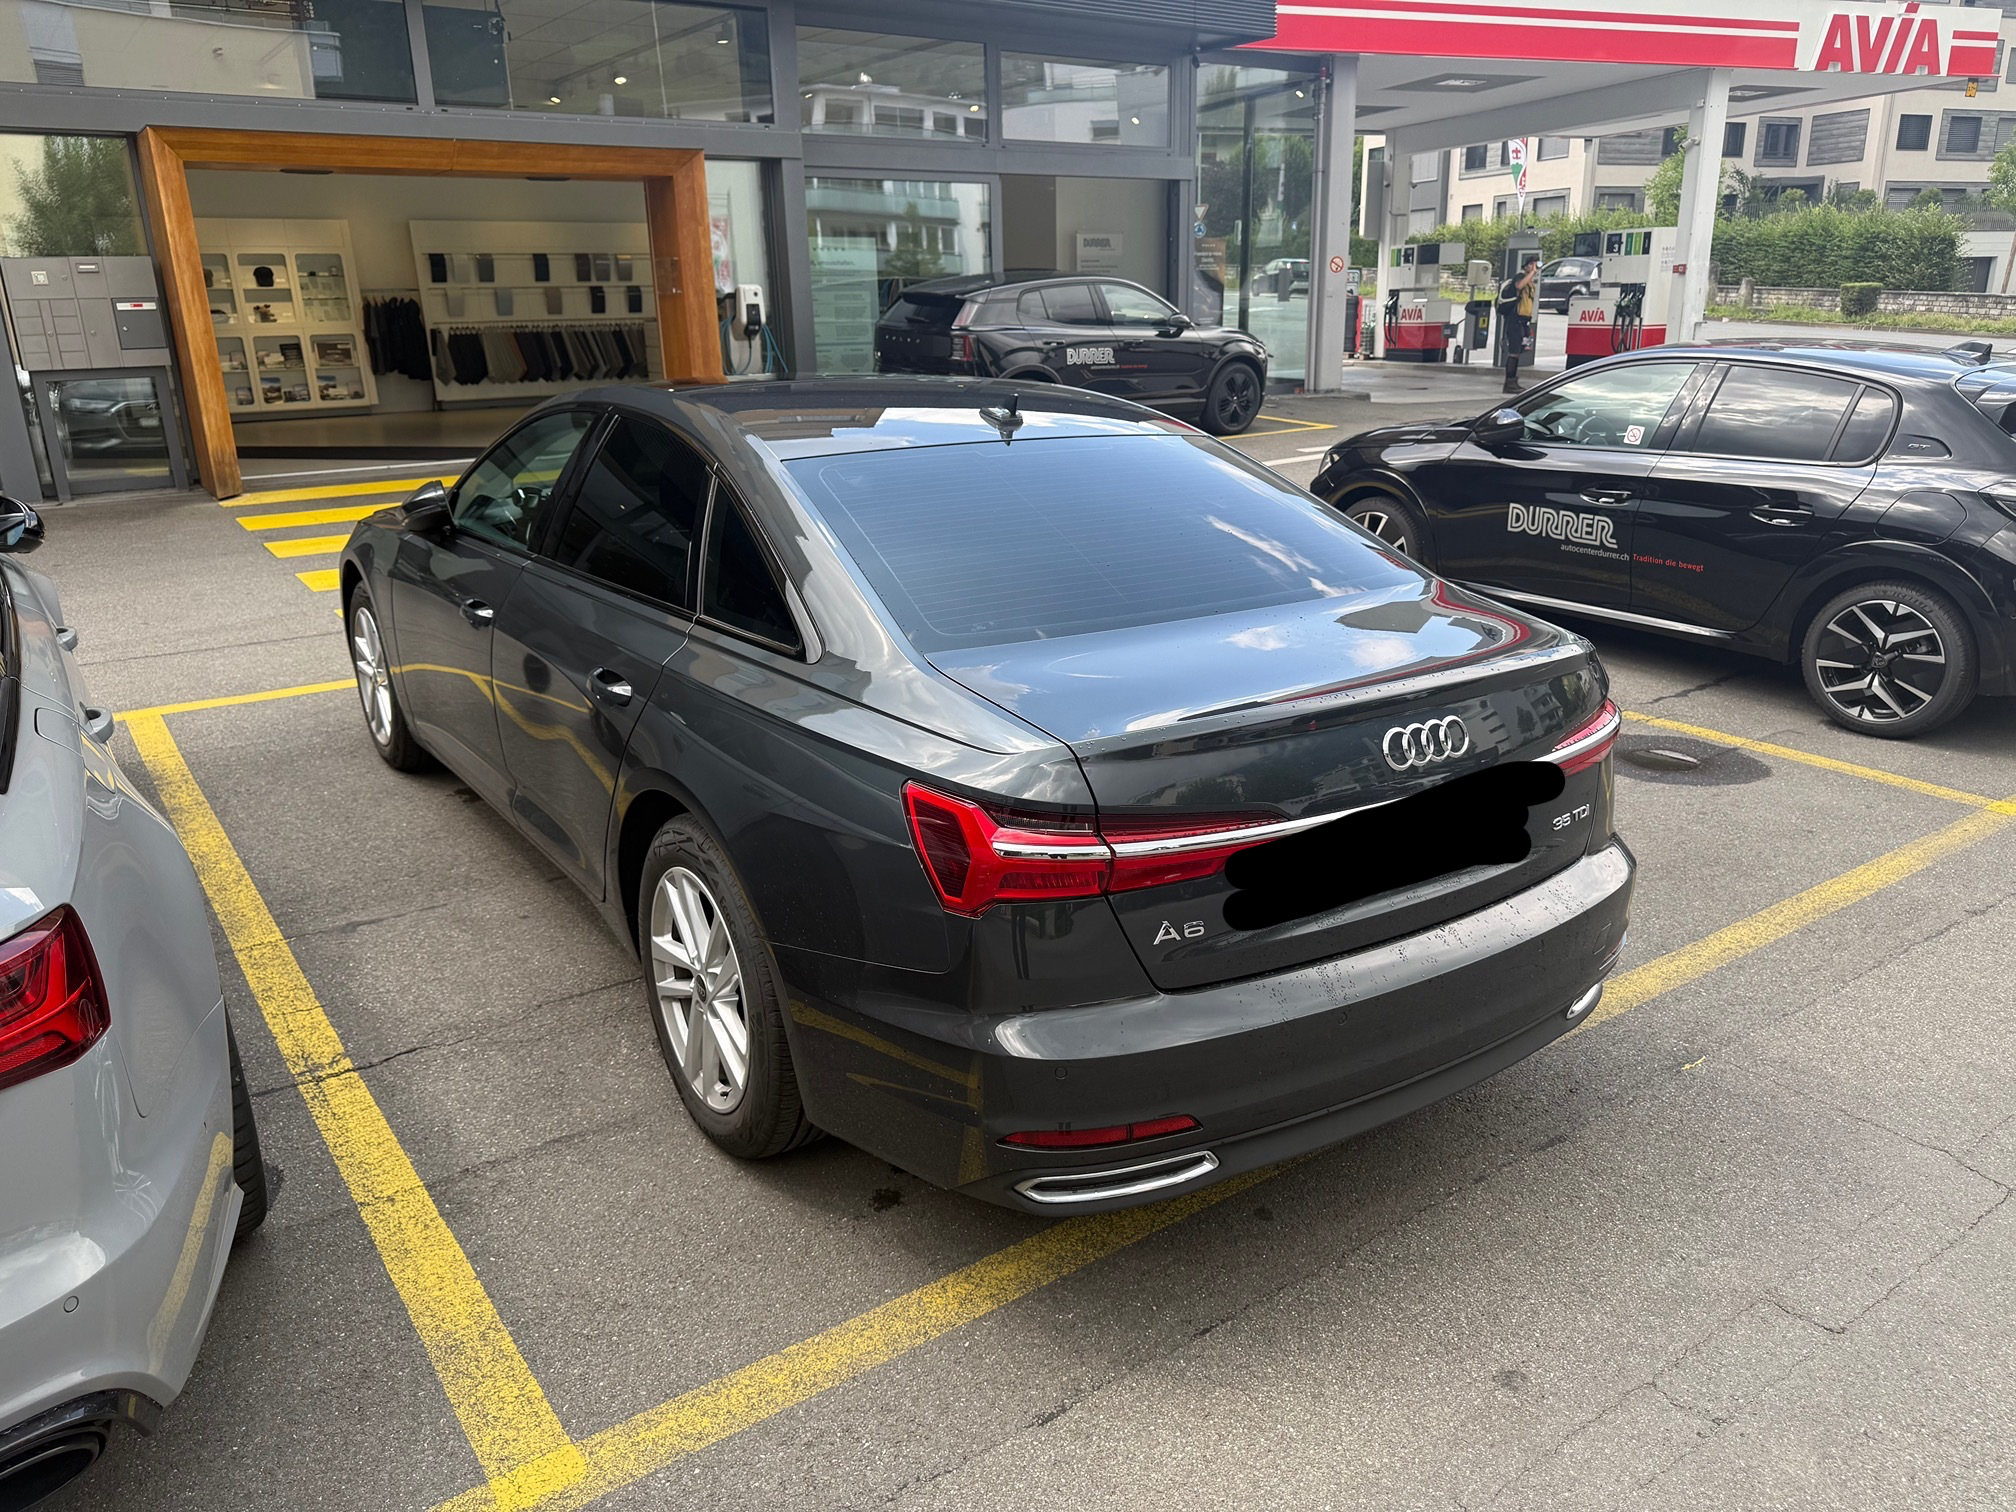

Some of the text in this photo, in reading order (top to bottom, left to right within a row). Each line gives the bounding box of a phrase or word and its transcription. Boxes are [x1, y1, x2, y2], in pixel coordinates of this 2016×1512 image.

[1814, 2, 1941, 76] AVIA
[1401, 307, 1423, 321] AVIA
[1579, 307, 1606, 322] AVIA
[1066, 347, 1116, 365] DURRER
[1507, 502, 1618, 549] DURRER
[1560, 543, 1704, 572] autocenterdurrer.ch Tradition die bewegt
[1552, 812, 1571, 831] 35
[1153, 920, 1205, 945] A6
